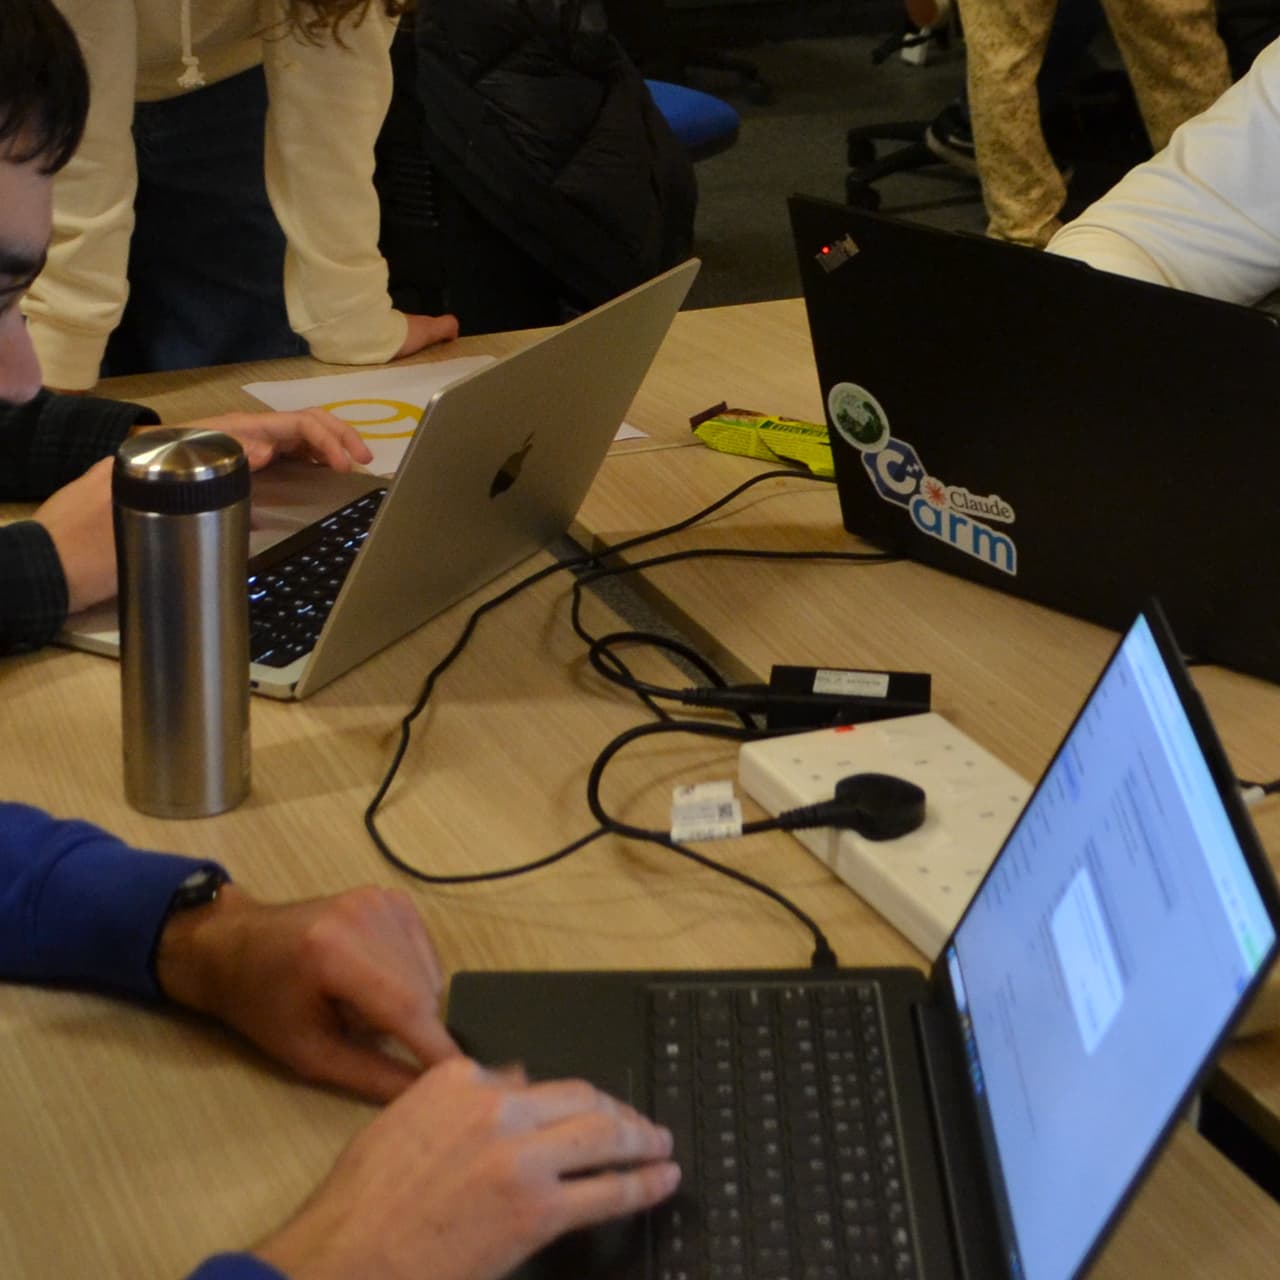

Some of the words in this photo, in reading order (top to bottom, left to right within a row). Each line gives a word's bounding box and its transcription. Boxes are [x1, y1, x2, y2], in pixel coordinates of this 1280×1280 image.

[876, 449, 920, 495] C++
[950, 491, 1011, 519] Claude
[912, 499, 1015, 571] arm
